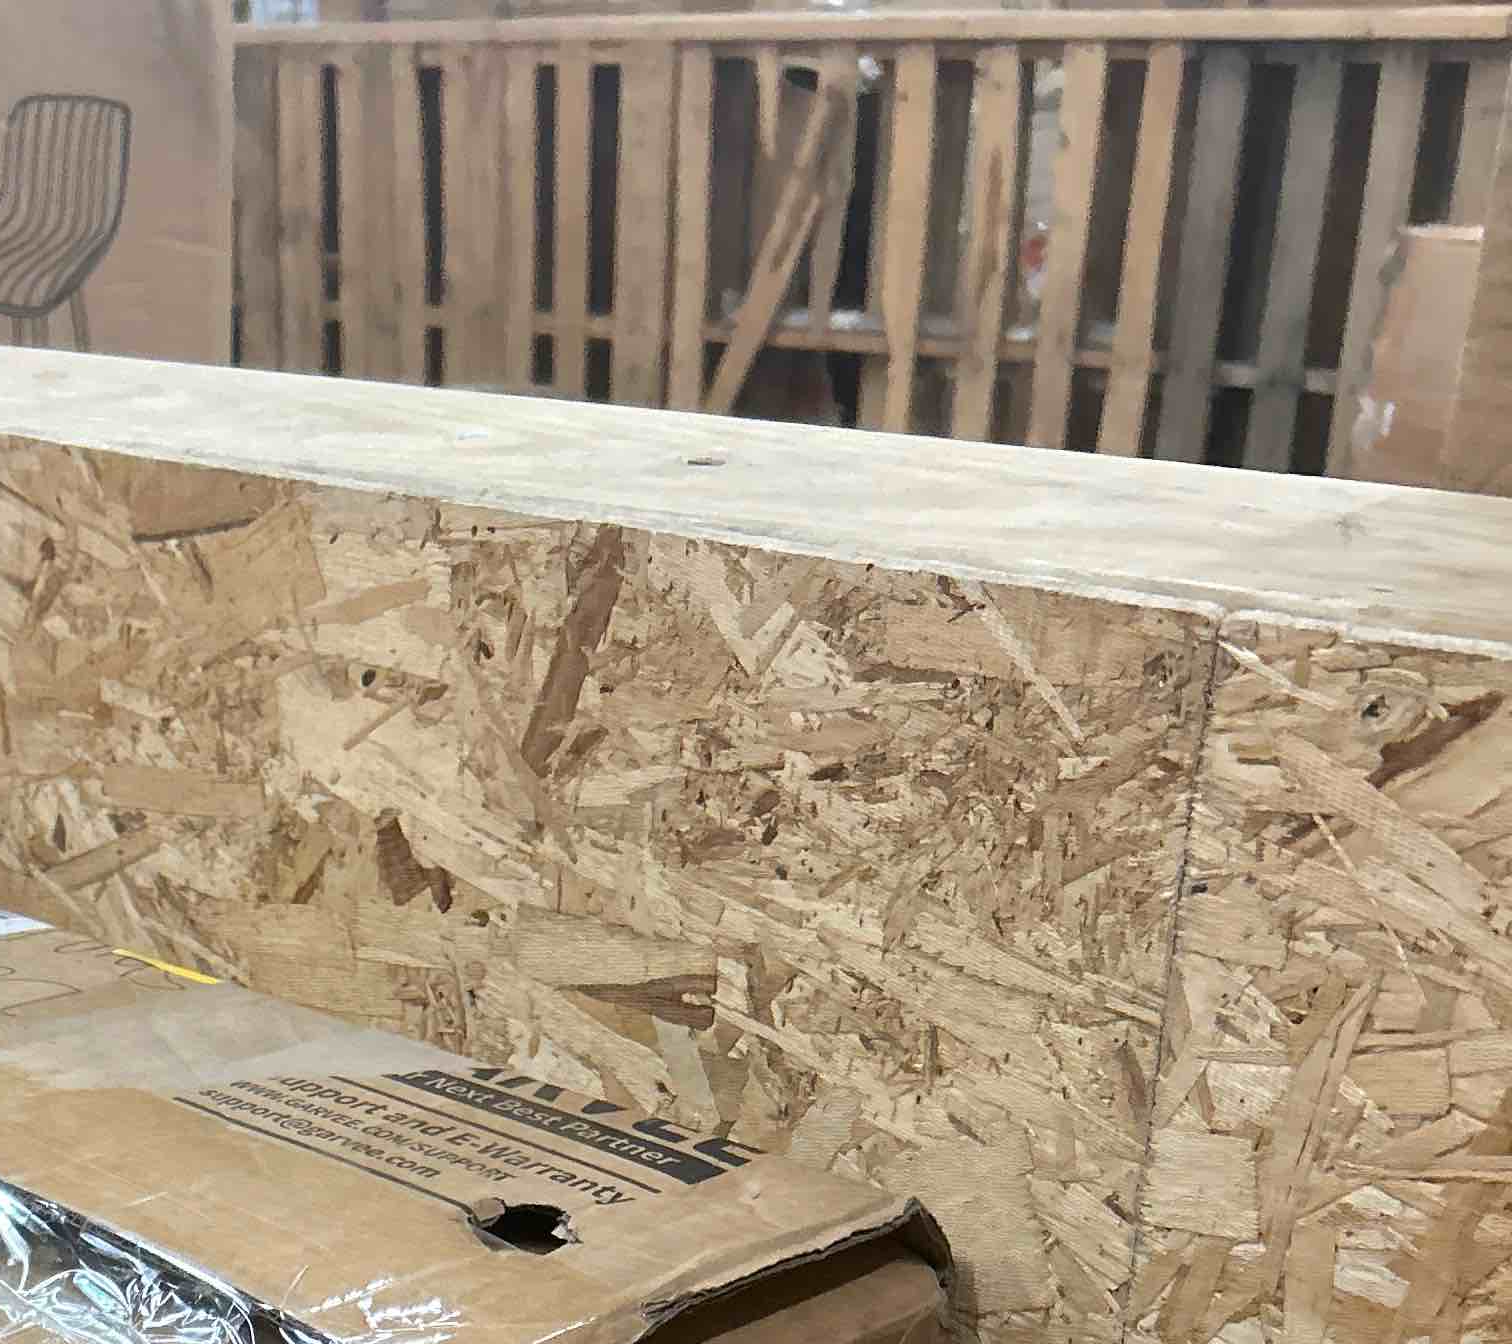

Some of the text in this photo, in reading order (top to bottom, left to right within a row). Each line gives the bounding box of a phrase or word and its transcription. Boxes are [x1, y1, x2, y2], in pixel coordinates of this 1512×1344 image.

[199, 1088, 442, 1180] support@garvee.com
[269, 1076, 389, 1116] upport
[382, 1110, 458, 1138] and
[446, 1132, 638, 1206] E-Warranty
[493, 1097, 563, 1126] Best
[560, 1115, 684, 1168] Partner
